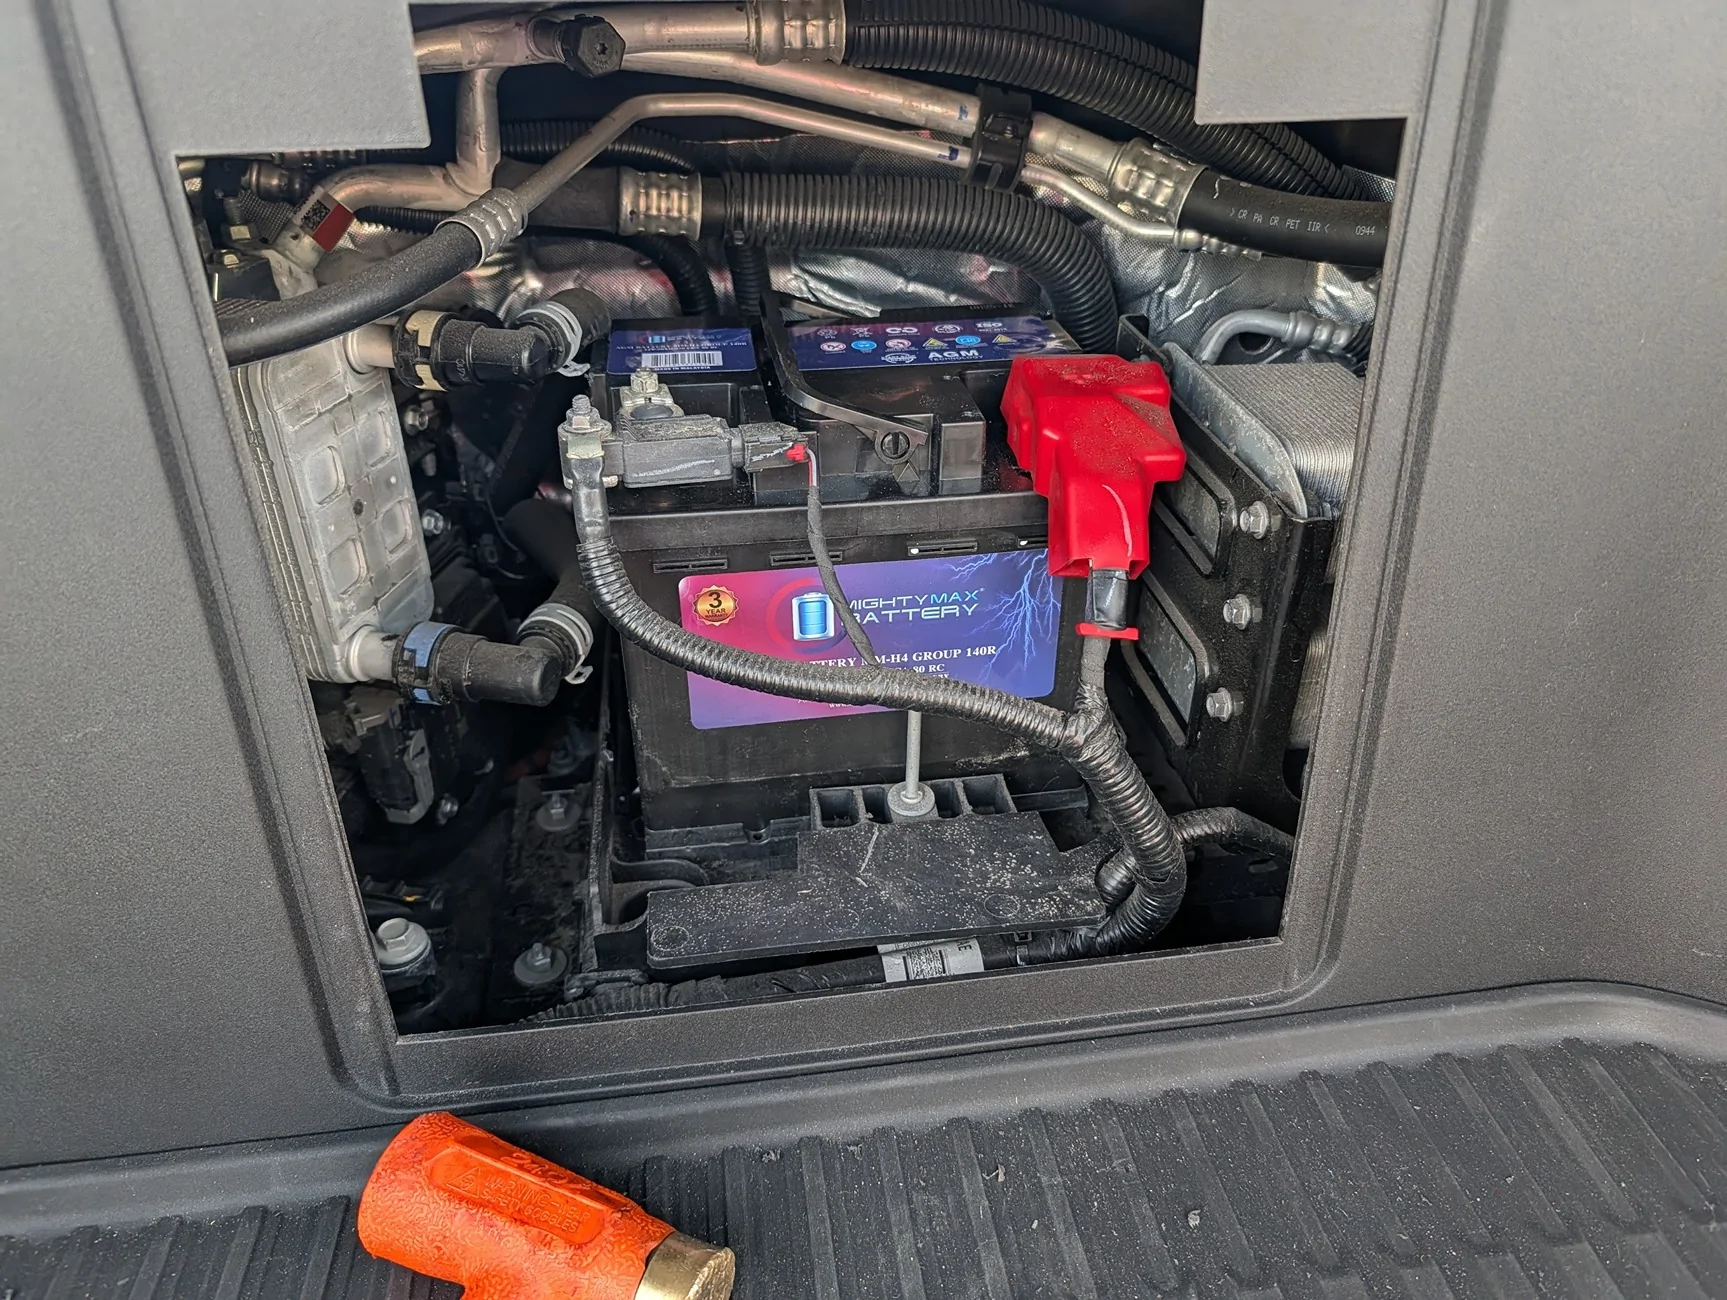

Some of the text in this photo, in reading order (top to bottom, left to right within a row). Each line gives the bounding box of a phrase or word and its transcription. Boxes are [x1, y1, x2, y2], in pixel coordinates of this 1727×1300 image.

[1253, 212, 1263, 223] PA
[1269, 216, 1280, 226] CR
[1285, 219, 1300, 230] PET
[1355, 225, 1376, 236] 0944
[928, 349, 979, 359] AGM
[708, 591, 723, 609] 3
[912, 649, 962, 662] GROUP
[966, 645, 997, 657] 140R
[928, 663, 945, 673] RC
[480, 1188, 579, 1233] SAFETY GOGGLES
